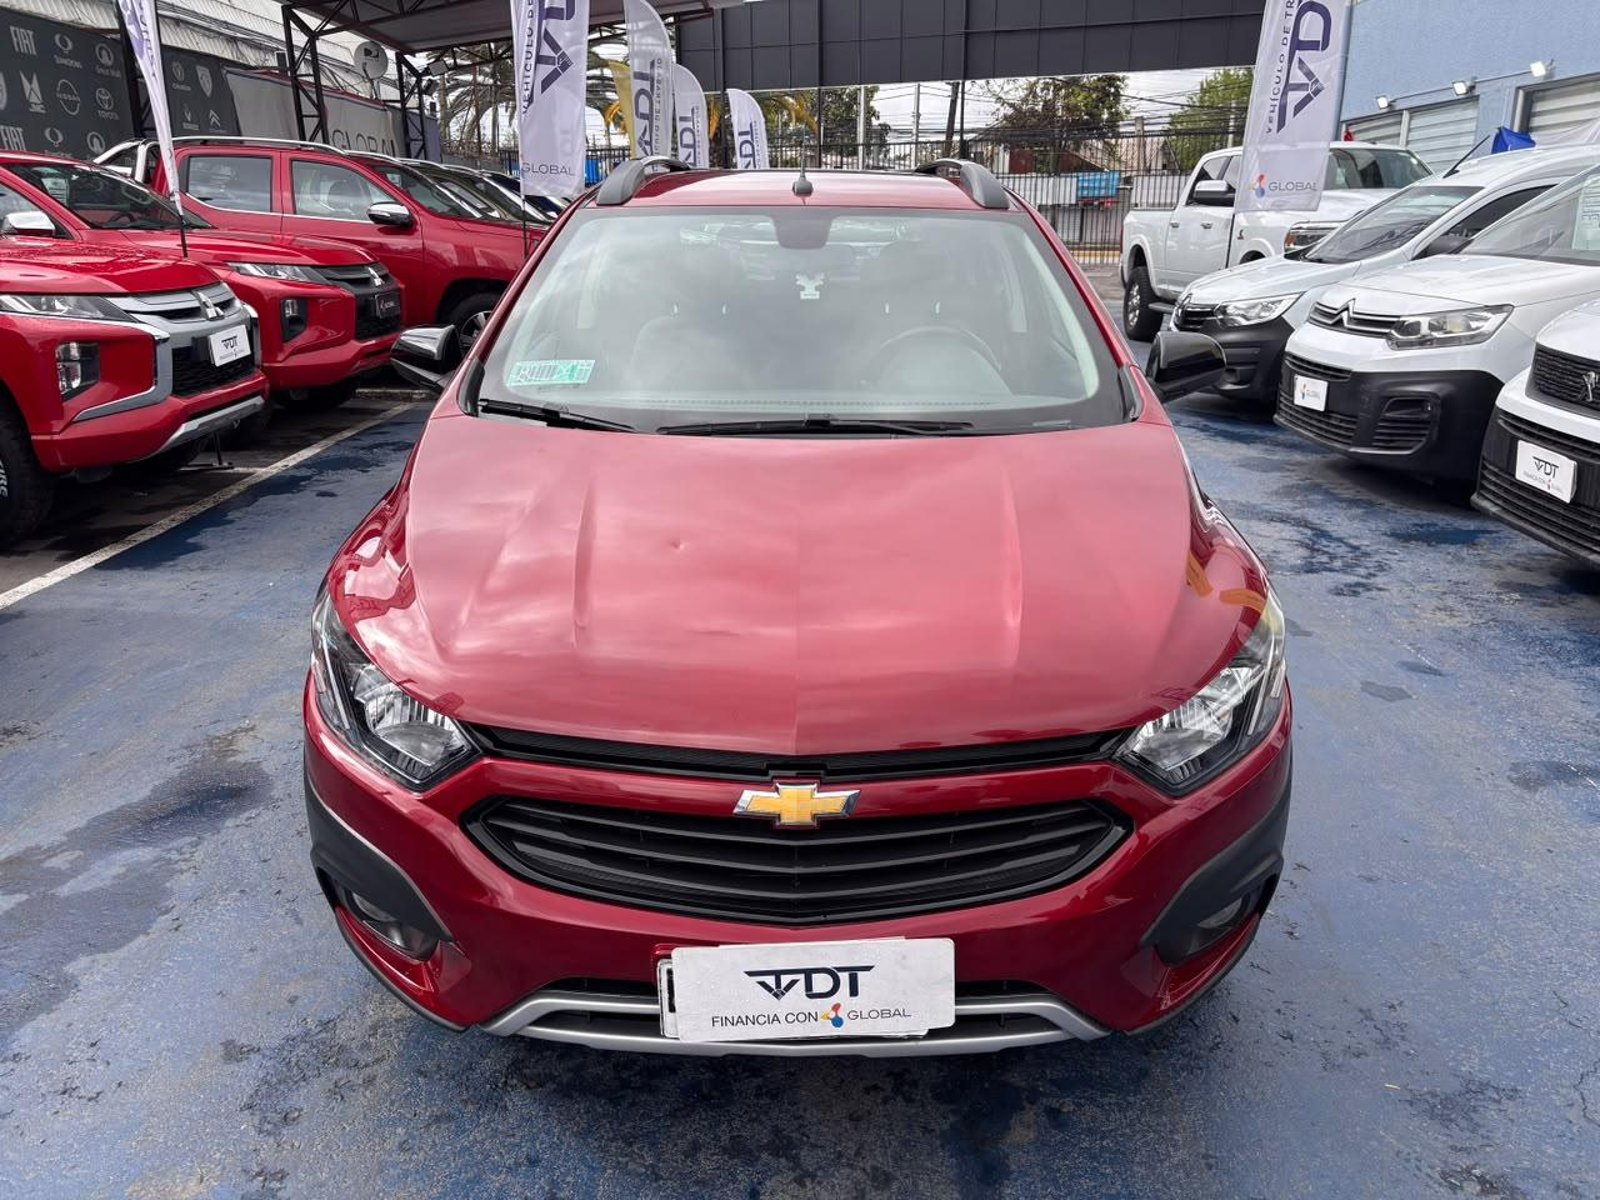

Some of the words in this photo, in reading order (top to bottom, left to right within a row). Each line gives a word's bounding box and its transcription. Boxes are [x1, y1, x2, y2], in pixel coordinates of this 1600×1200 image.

[10, 26, 37, 55] FIAT
[1281, 26, 1291, 46] DE
[522, 162, 576, 177] GLOBAL
[1269, 181, 1318, 192] GLOBAL
[712, 1013, 782, 1028] FINANCIA
[785, 1011, 819, 1024] CON
[847, 1007, 912, 1021] GLOBAL
